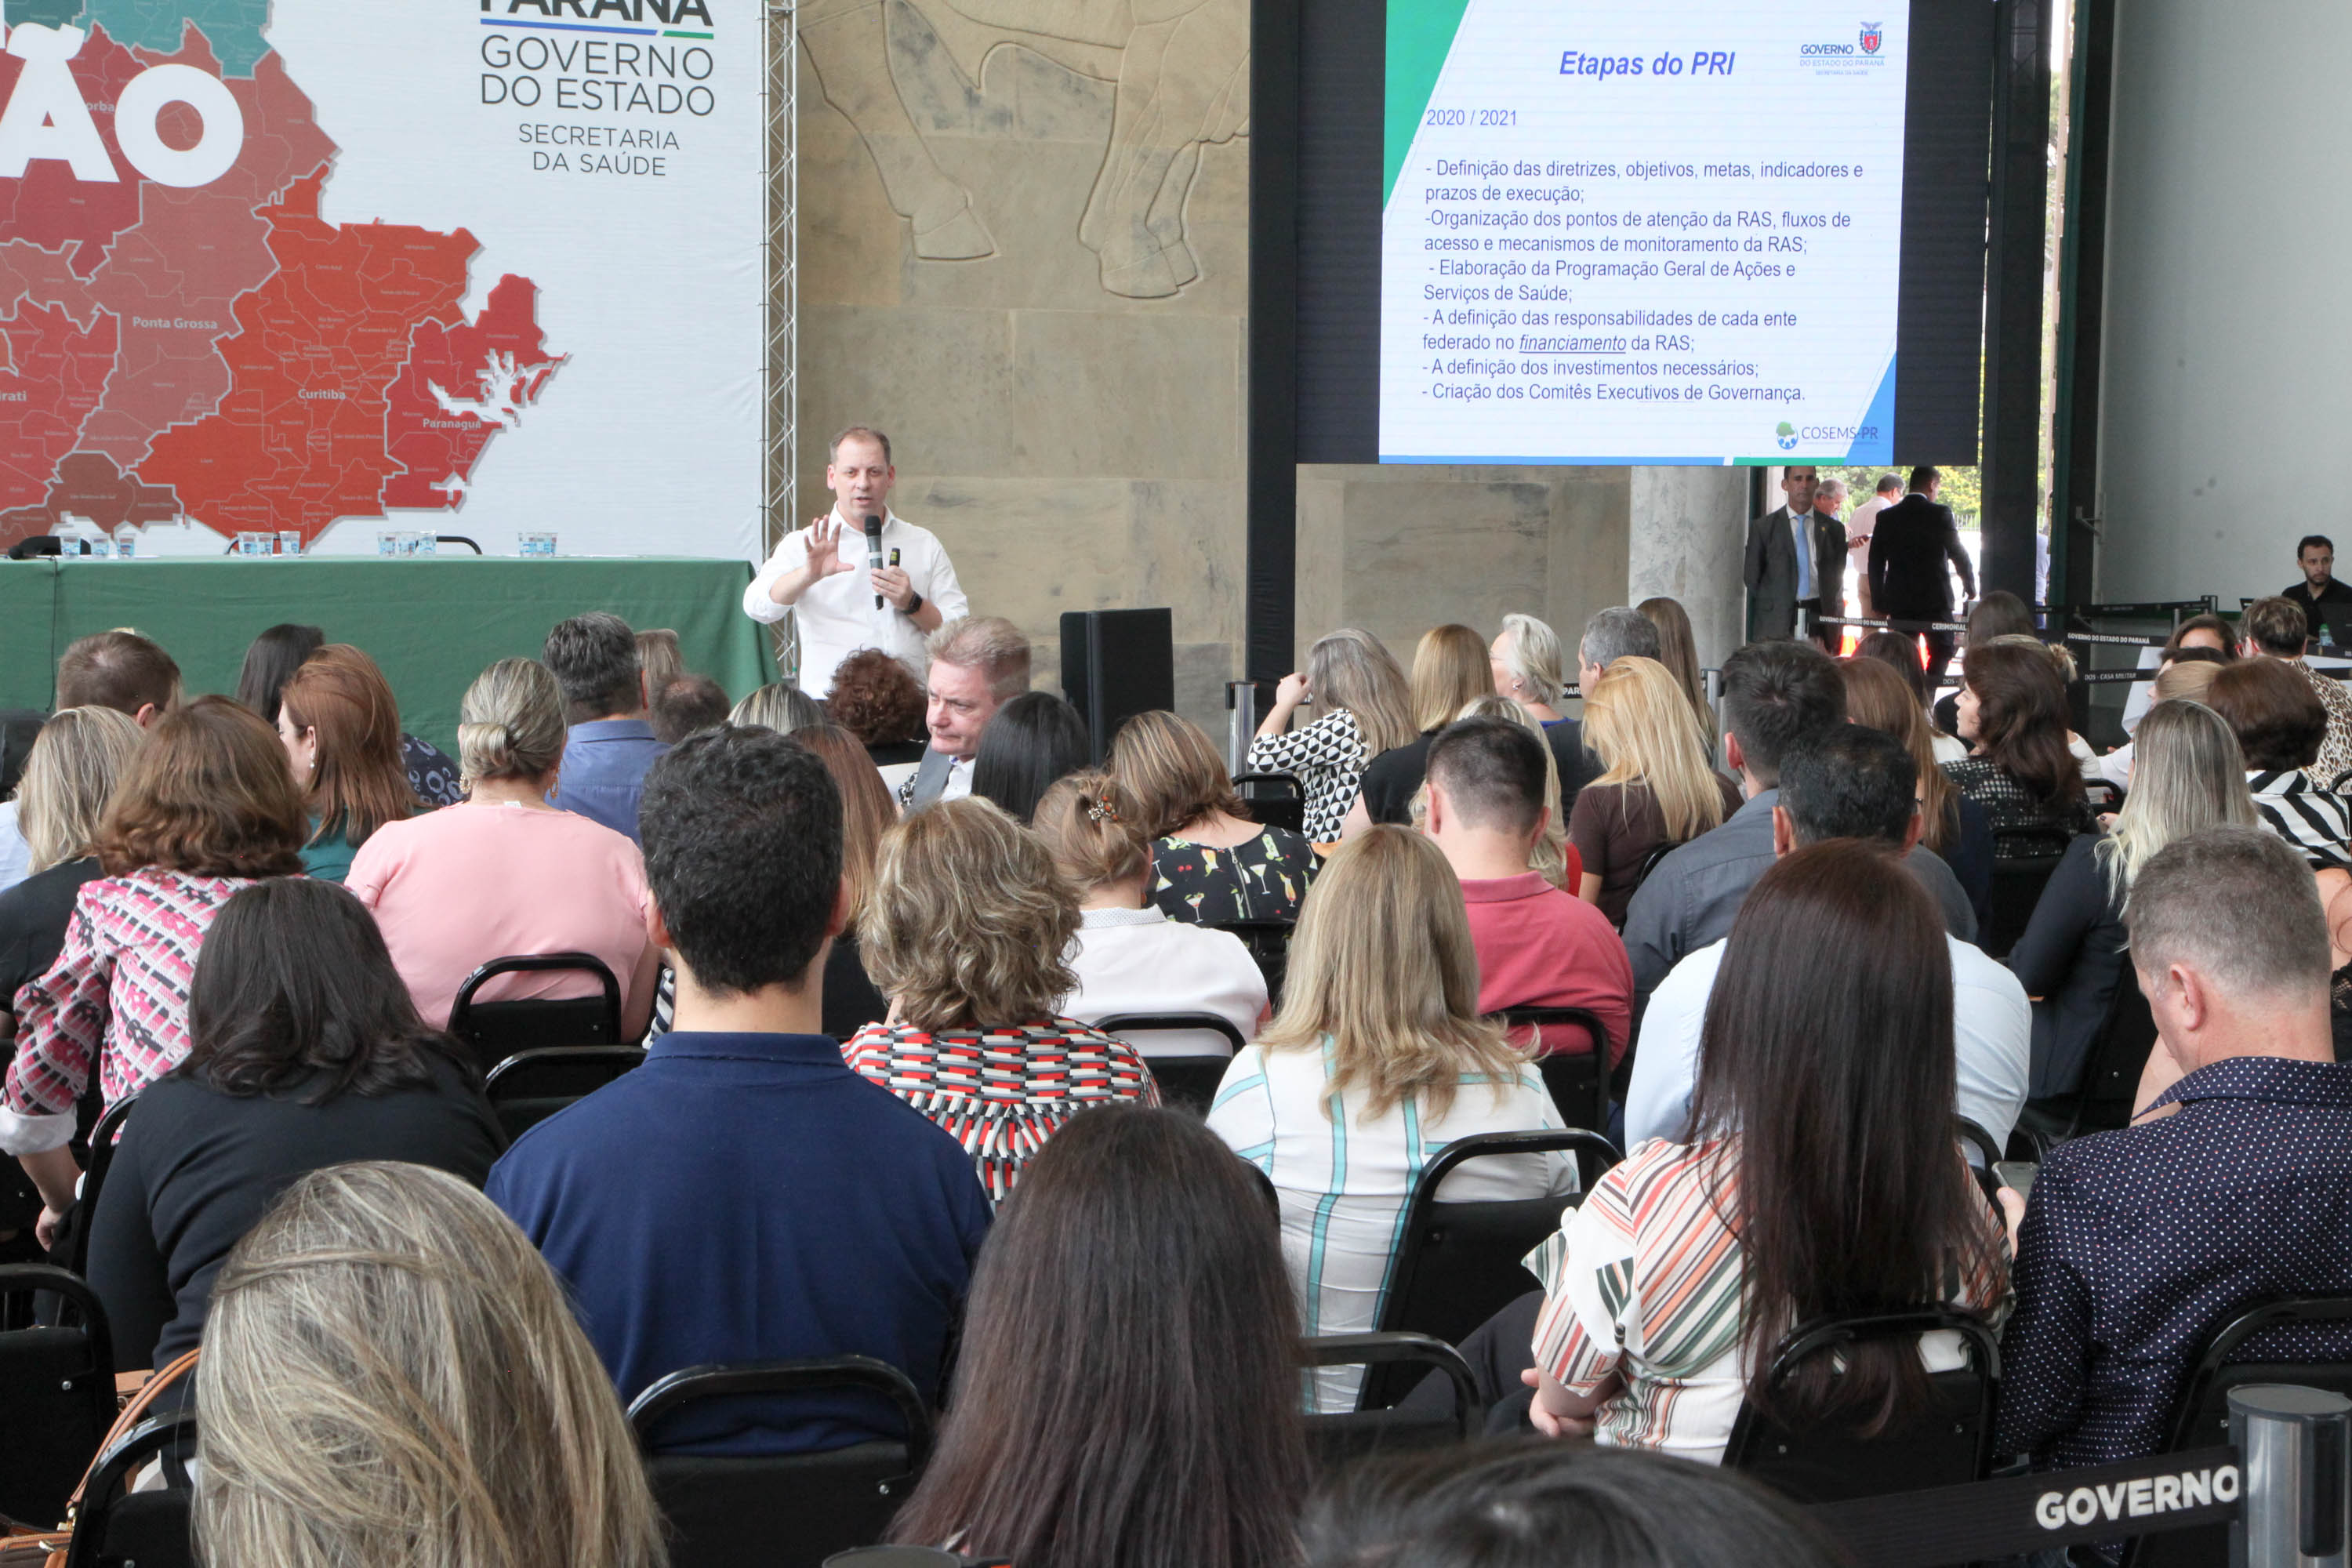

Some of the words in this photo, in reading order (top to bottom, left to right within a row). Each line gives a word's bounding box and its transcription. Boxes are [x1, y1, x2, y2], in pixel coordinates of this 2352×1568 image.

[481, 34, 714, 81] GOVERNO
[1801, 45, 1854, 54] GOVERNO
[1559, 50, 1643, 81] Etapas
[1652, 51, 1683, 75] do
[1691, 51, 1736, 75] PRI
[86, 100, 115, 112] orba
[481, 74, 541, 105] DO
[557, 78, 715, 117] ESTADO
[1426, 110, 1465, 125] 2020
[1471, 110, 1475, 125] /
[1480, 110, 1515, 125] 2021
[519, 123, 680, 150] SECRETARIA
[533, 151, 570, 172] DA
[580, 151, 666, 176] SAÚDE
[1437, 159, 1508, 180] Definição
[1514, 160, 1541, 176] das
[1546, 161, 1620, 179] diretrizes,
[1626, 161, 1697, 180] objetivos,
[1704, 162, 1754, 179] metas,
[1761, 162, 1849, 177] indicadores
[1854, 165, 1863, 177] e
[1426, 188, 1477, 204] prazos
[1483, 184, 1501, 200] de
[1506, 186, 1584, 205] execução;
[1425, 209, 1528, 230] -Organização
[1534, 210, 1561, 226] dos
[1566, 212, 1617, 230] pontos
[1623, 211, 1641, 226] de
[1647, 212, 1708, 230] atenção
[1713, 211, 1731, 227] da
[1738, 211, 1776, 230] RAS,
[1782, 211, 1826, 227] fluxos
[1832, 212, 1850, 227] de
[1425, 238, 1479, 250] acesso
[1484, 239, 1493, 250] e
[1499, 236, 1595, 251] mecanismos
[1600, 236, 1618, 251] de
[1624, 236, 1738, 251] monitoramento
[1744, 234, 1762, 252] da
[1769, 236, 1806, 255] RAS;
[1440, 260, 1526, 279] Elaboração
[1531, 260, 1549, 275] da
[1556, 260, 1658, 280] Programação
[1664, 260, 1705, 276] Geral
[1711, 261, 1729, 276] de
[1733, 260, 1780, 281] Ações
[1787, 265, 1795, 276] e
[1424, 285, 1489, 304] Serviços
[1495, 285, 1513, 300] de
[1519, 285, 1572, 303] Saúde;
[132, 316, 171, 328] Ponta
[174, 317, 218, 330] Grossa
[1433, 309, 1444, 325] A
[1448, 309, 1516, 328] definição
[1522, 310, 1548, 325] das
[1555, 310, 1693, 329] responsabilidades
[1698, 310, 1716, 325] de
[1722, 310, 1758, 326] cada
[1764, 311, 1797, 326] ente
[1423, 334, 1490, 349] federado
[1496, 337, 1514, 350] no
[1519, 334, 1626, 354] financiamento
[1632, 335, 1650, 350] da
[1656, 335, 1693, 352] RAS;
[1432, 358, 1443, 374] A
[1447, 358, 1515, 379] definição
[1521, 359, 1548, 375] dos
[1554, 359, 1657, 375] investimentos
[1664, 359, 1758, 378] necessários;
[0, 390, 27, 401] rati
[298, 389, 346, 400] Curitiba
[1433, 383, 1491, 402] Criação
[1497, 383, 1523, 398] dos
[1530, 383, 1592, 399] Comitês
[1598, 384, 1679, 402] Executivos
[1684, 384, 1703, 400] de
[1709, 384, 1805, 404] Governança.
[1802, 426, 1878, 440] COSEMS-PR
[1931, 622, 1967, 631] CERIMONIAL
[2035, 1465, 2239, 1531] GOVERNO
